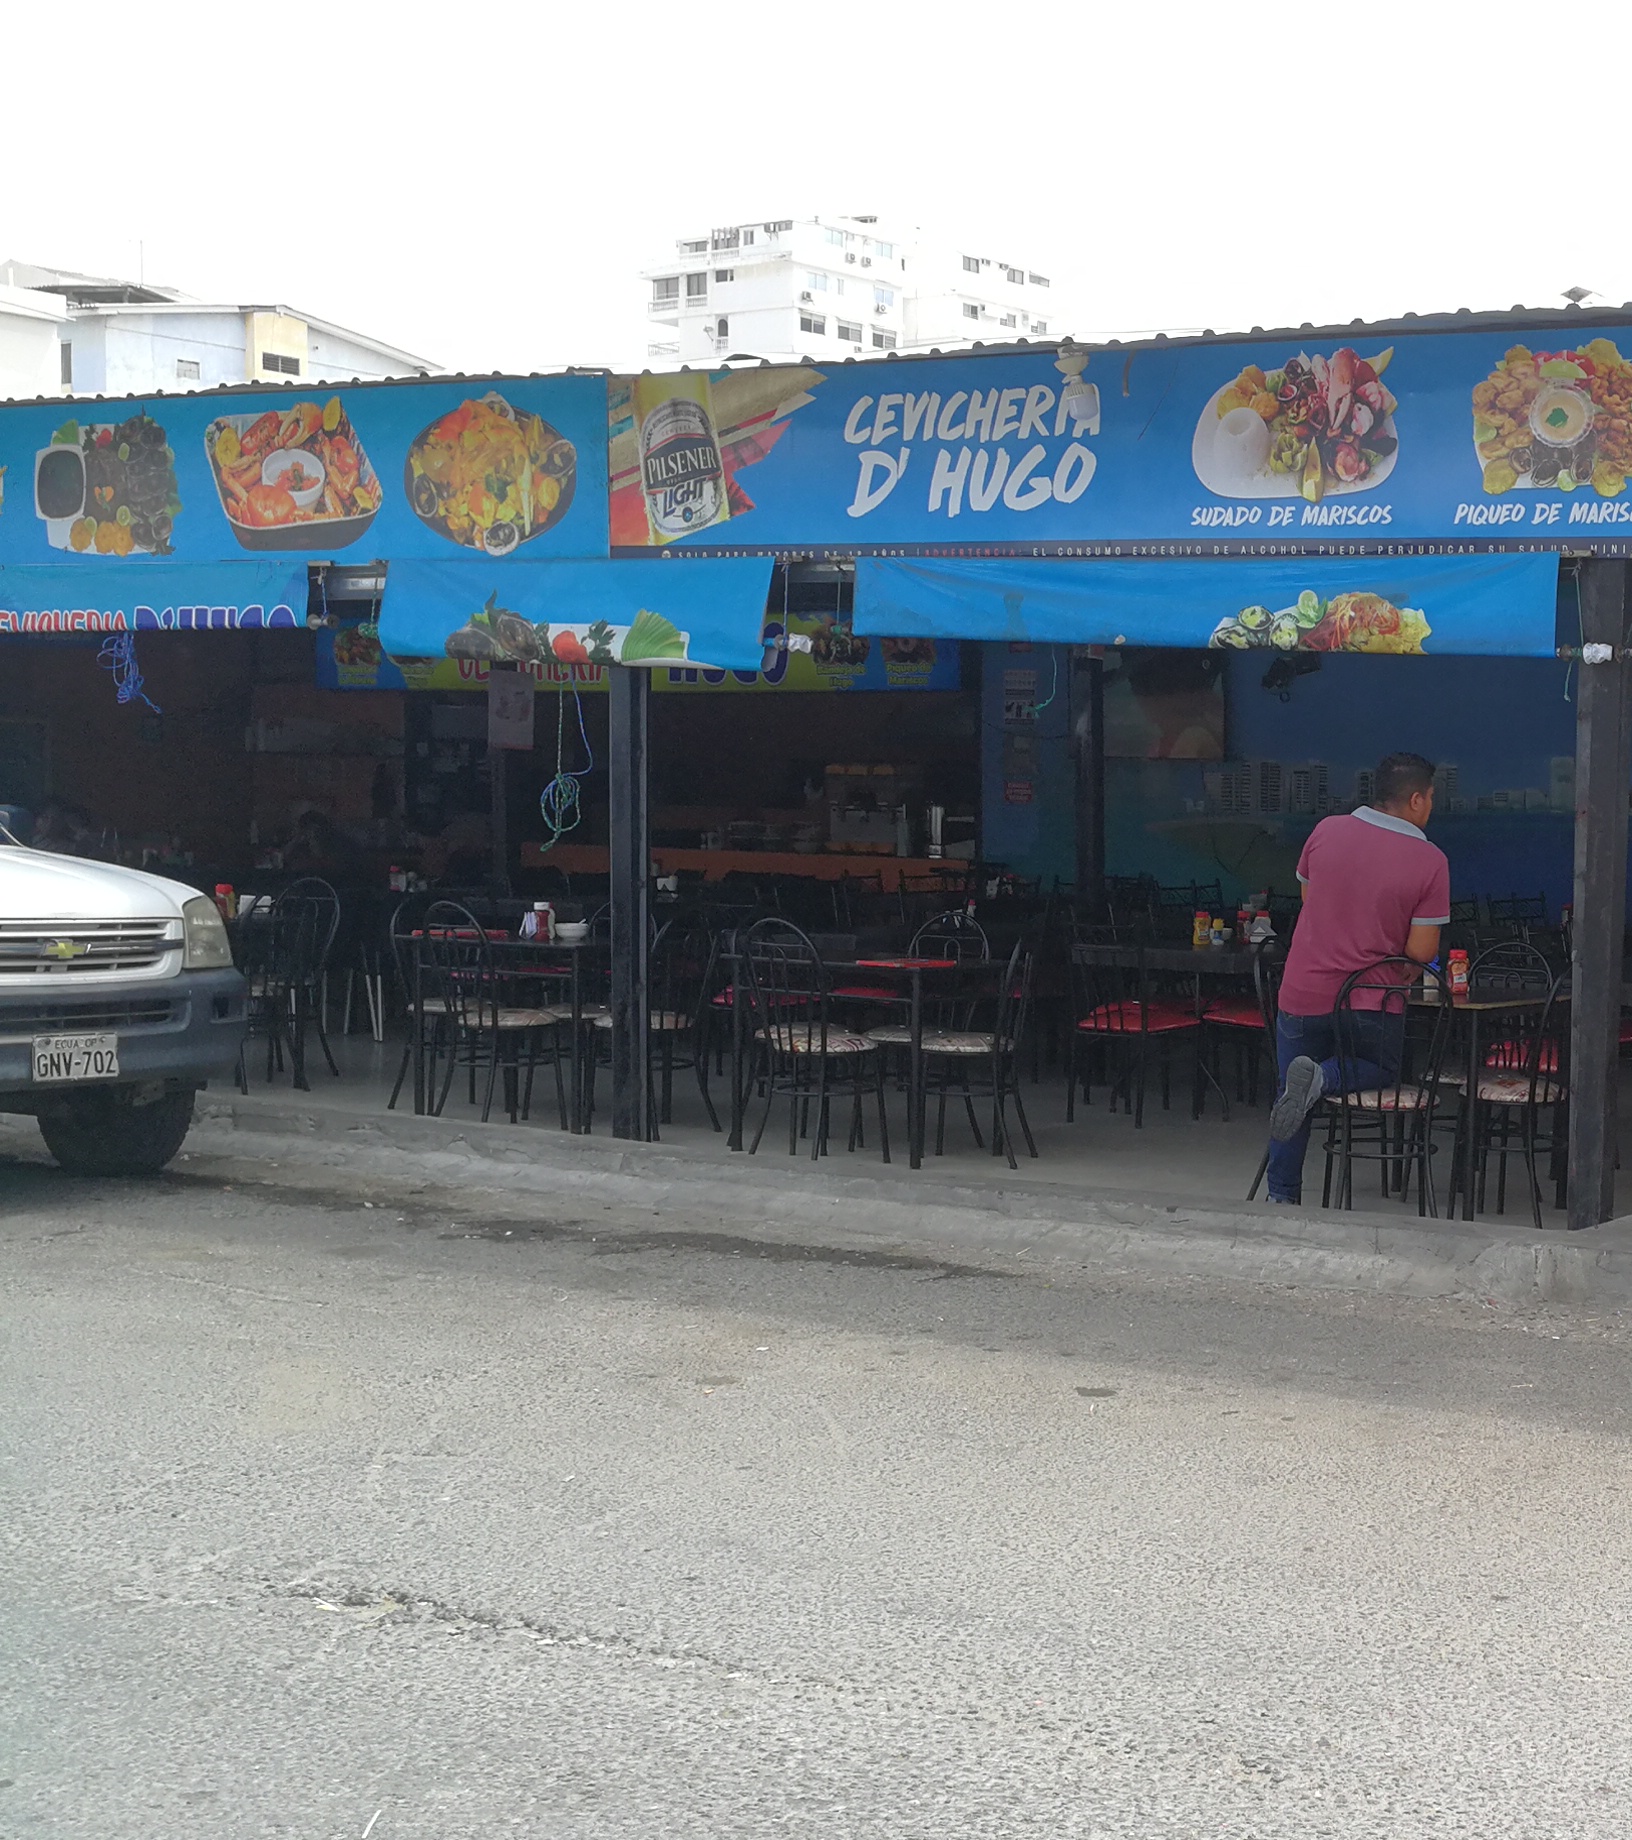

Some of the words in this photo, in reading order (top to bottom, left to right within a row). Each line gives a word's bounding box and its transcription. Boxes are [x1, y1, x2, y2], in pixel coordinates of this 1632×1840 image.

[647, 446, 717, 485] PILSENER
[928, 442, 1097, 518] HUGO
[663, 478, 708, 519] LIGHT
[1191, 505, 1262, 527] SUDADO
[1267, 505, 1295, 527] DE
[1301, 504, 1393, 526] MARISCOS
[1453, 503, 1525, 526] PIQUEO
[1531, 503, 1560, 525] DE
[1033, 548, 1047, 557] EL
[1057, 546, 1122, 557] CONSUMO
[1132, 545, 1202, 556] EXCESIVO
[1213, 546, 1229, 555] DE
[1241, 545, 1307, 555] ALCOHOL
[1319, 545, 1366, 555] PUEDE
[1377, 545, 1476, 555] PERJUDICAR
[37, 1050, 116, 1077] GNV-702
